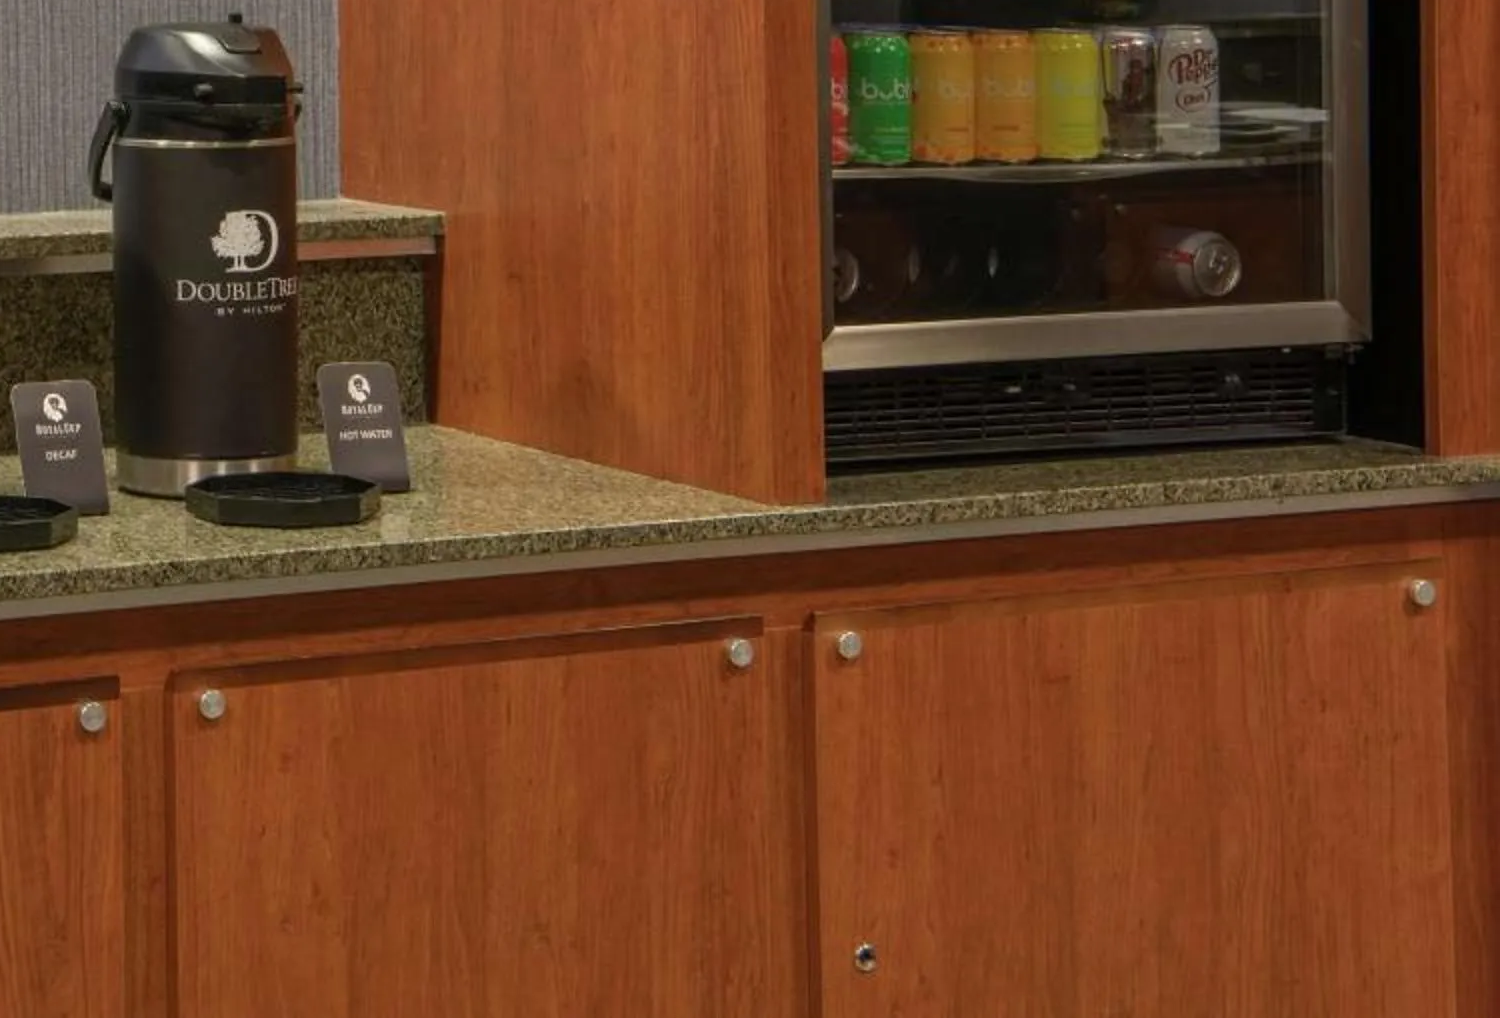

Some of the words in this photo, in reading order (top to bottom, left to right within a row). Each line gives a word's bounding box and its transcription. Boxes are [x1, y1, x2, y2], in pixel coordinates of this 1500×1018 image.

[340, 430, 358, 441] HOT
[360, 429, 393, 439] WATER
[45, 449, 78, 461] DECAF
